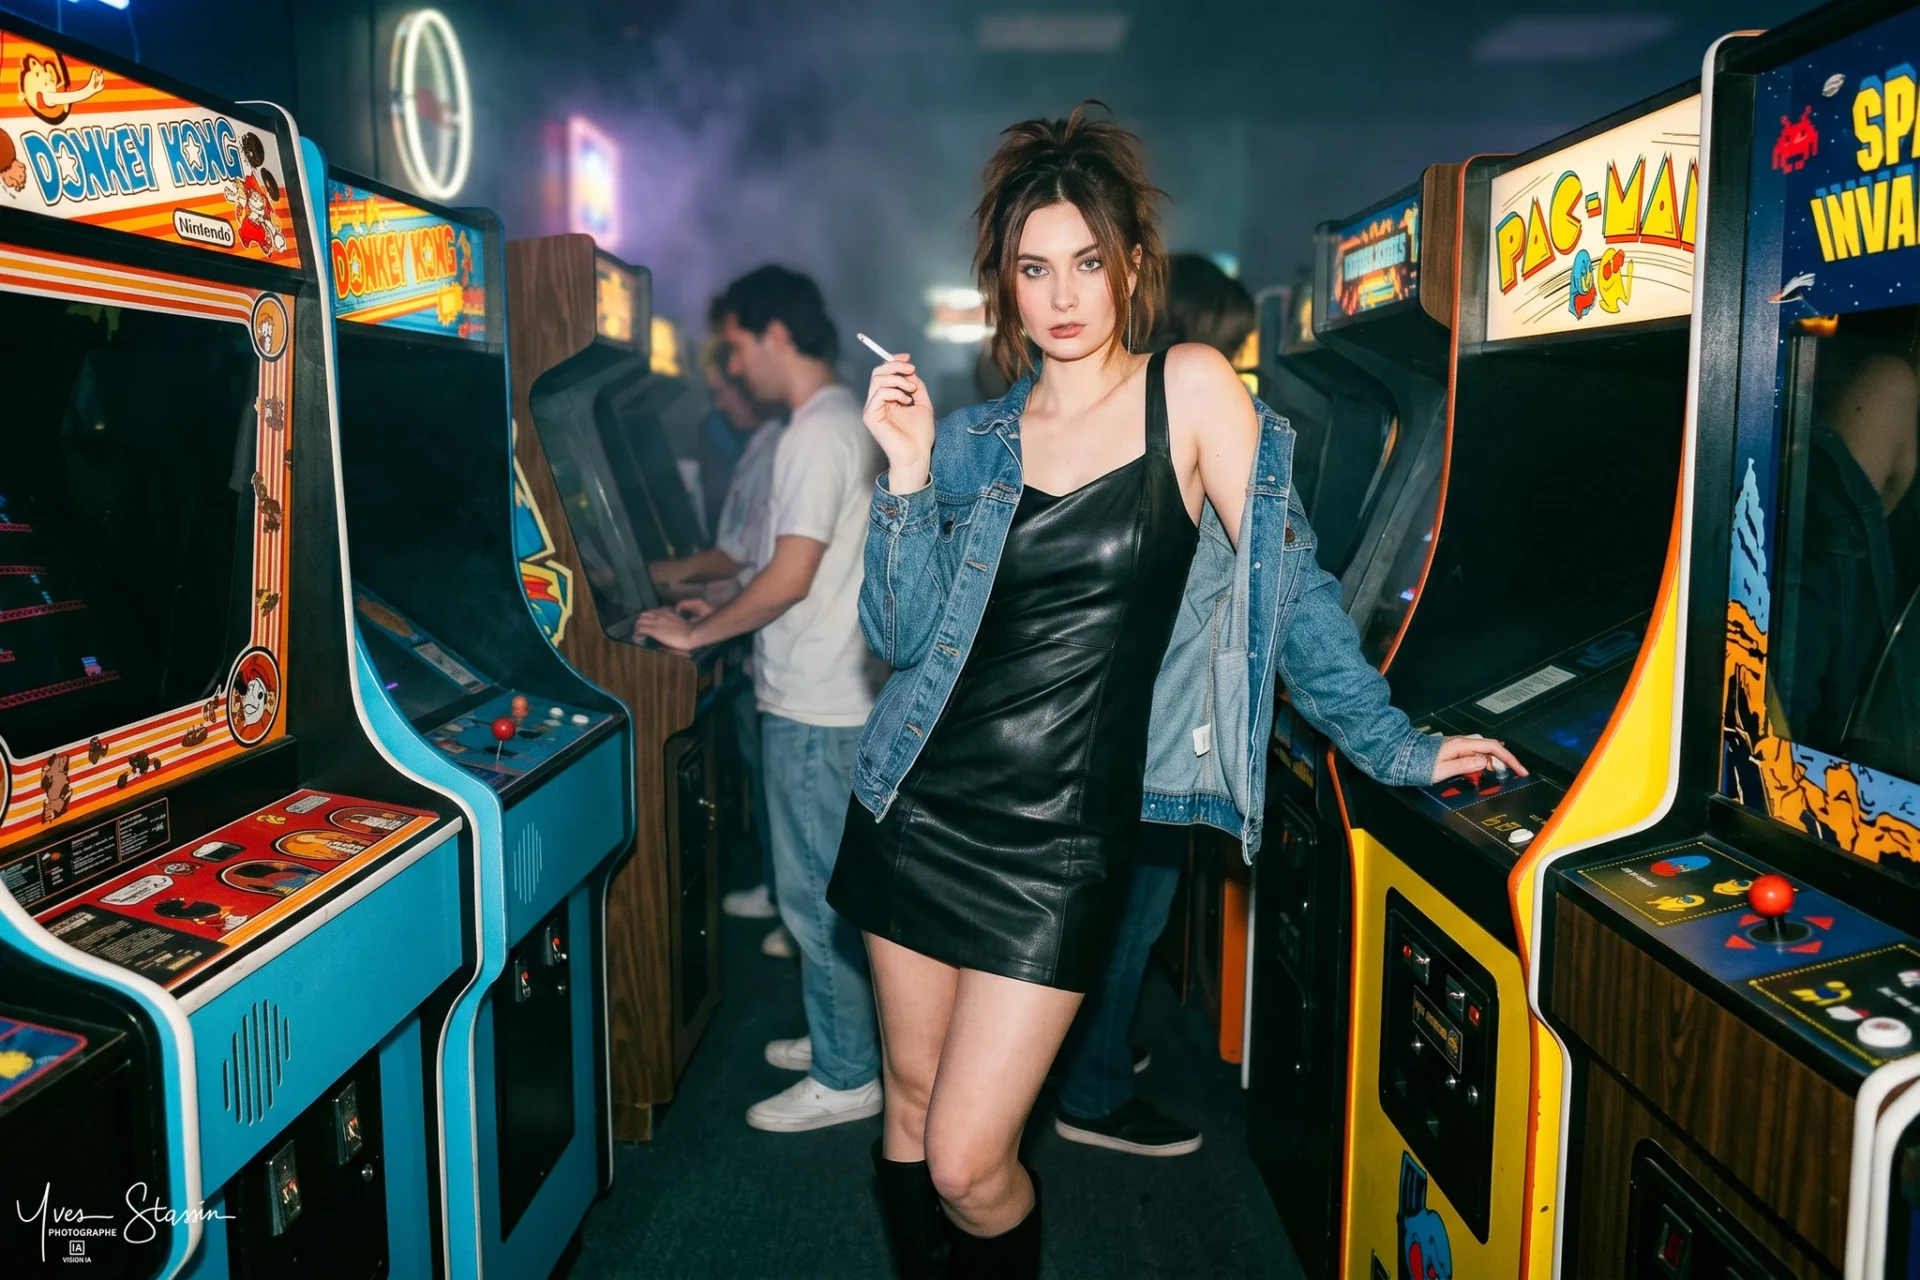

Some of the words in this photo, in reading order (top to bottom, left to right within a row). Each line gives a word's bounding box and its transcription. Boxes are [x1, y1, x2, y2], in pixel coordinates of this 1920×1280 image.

[21, 123, 159, 206] DONKEY
[158, 117, 244, 188] KONG
[178, 217, 231, 242] Nintendo
[1810, 168, 1920, 262] INVA
[331, 231, 407, 300] DONKEY
[408, 224, 457, 284] KONG
